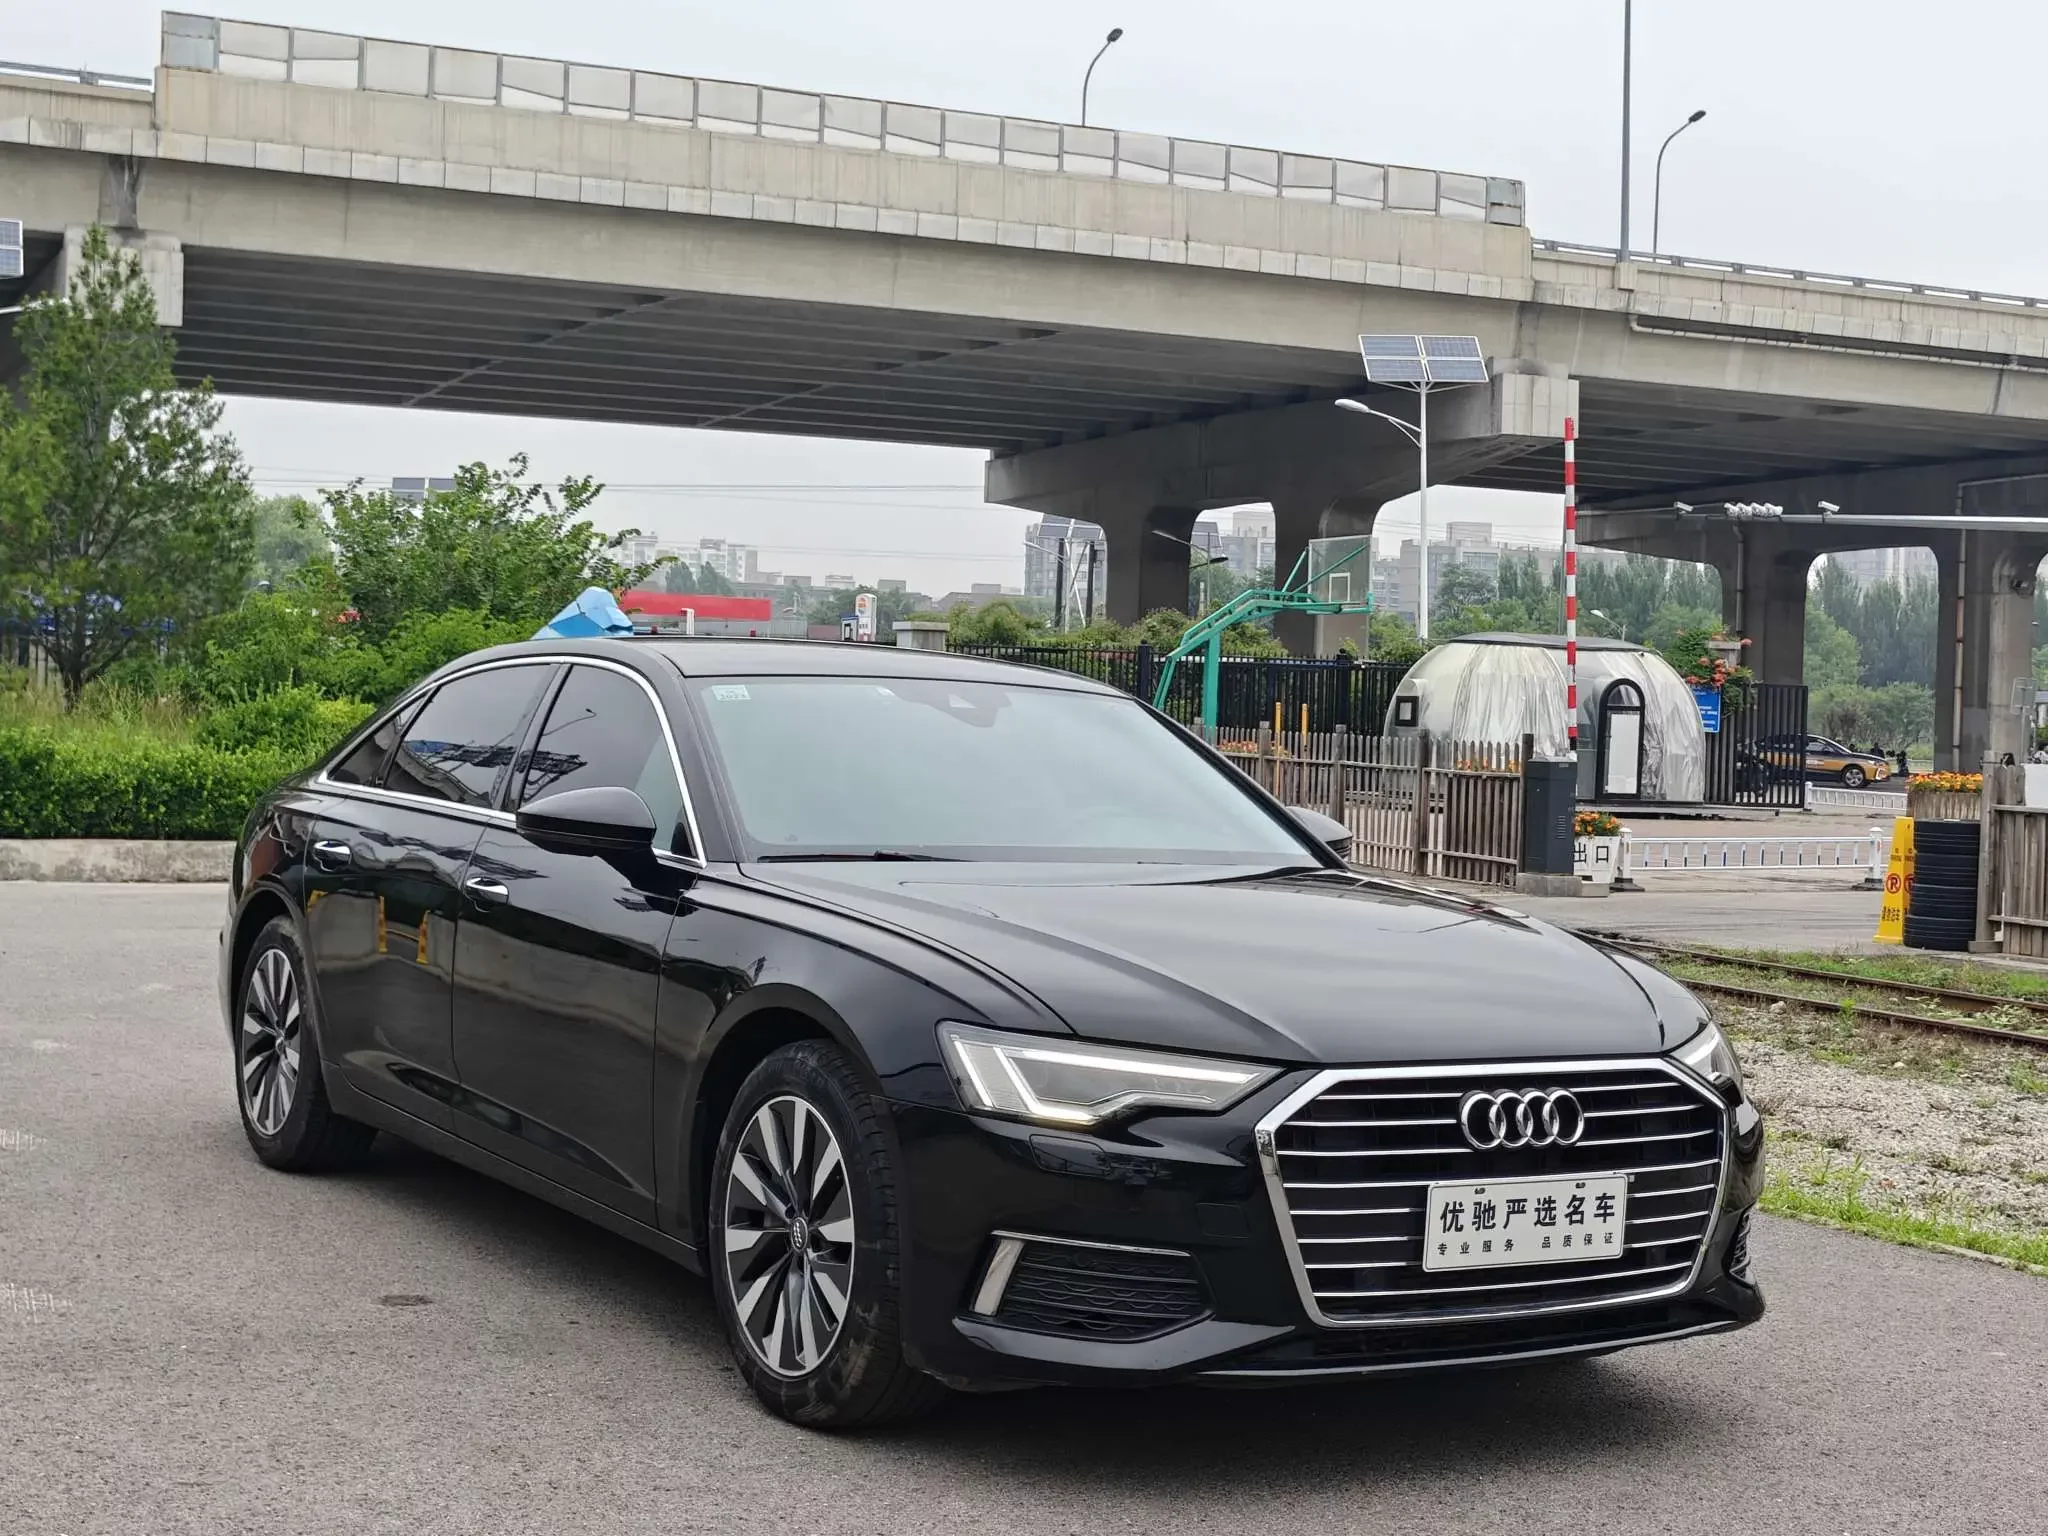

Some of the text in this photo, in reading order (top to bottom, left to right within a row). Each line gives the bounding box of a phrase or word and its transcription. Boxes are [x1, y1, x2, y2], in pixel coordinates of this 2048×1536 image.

[1573, 842, 1609, 864] 出口
[1439, 1192, 1616, 1234] 优驰严选名车
[1437, 1232, 1614, 1256] 专业服务 品质保证
